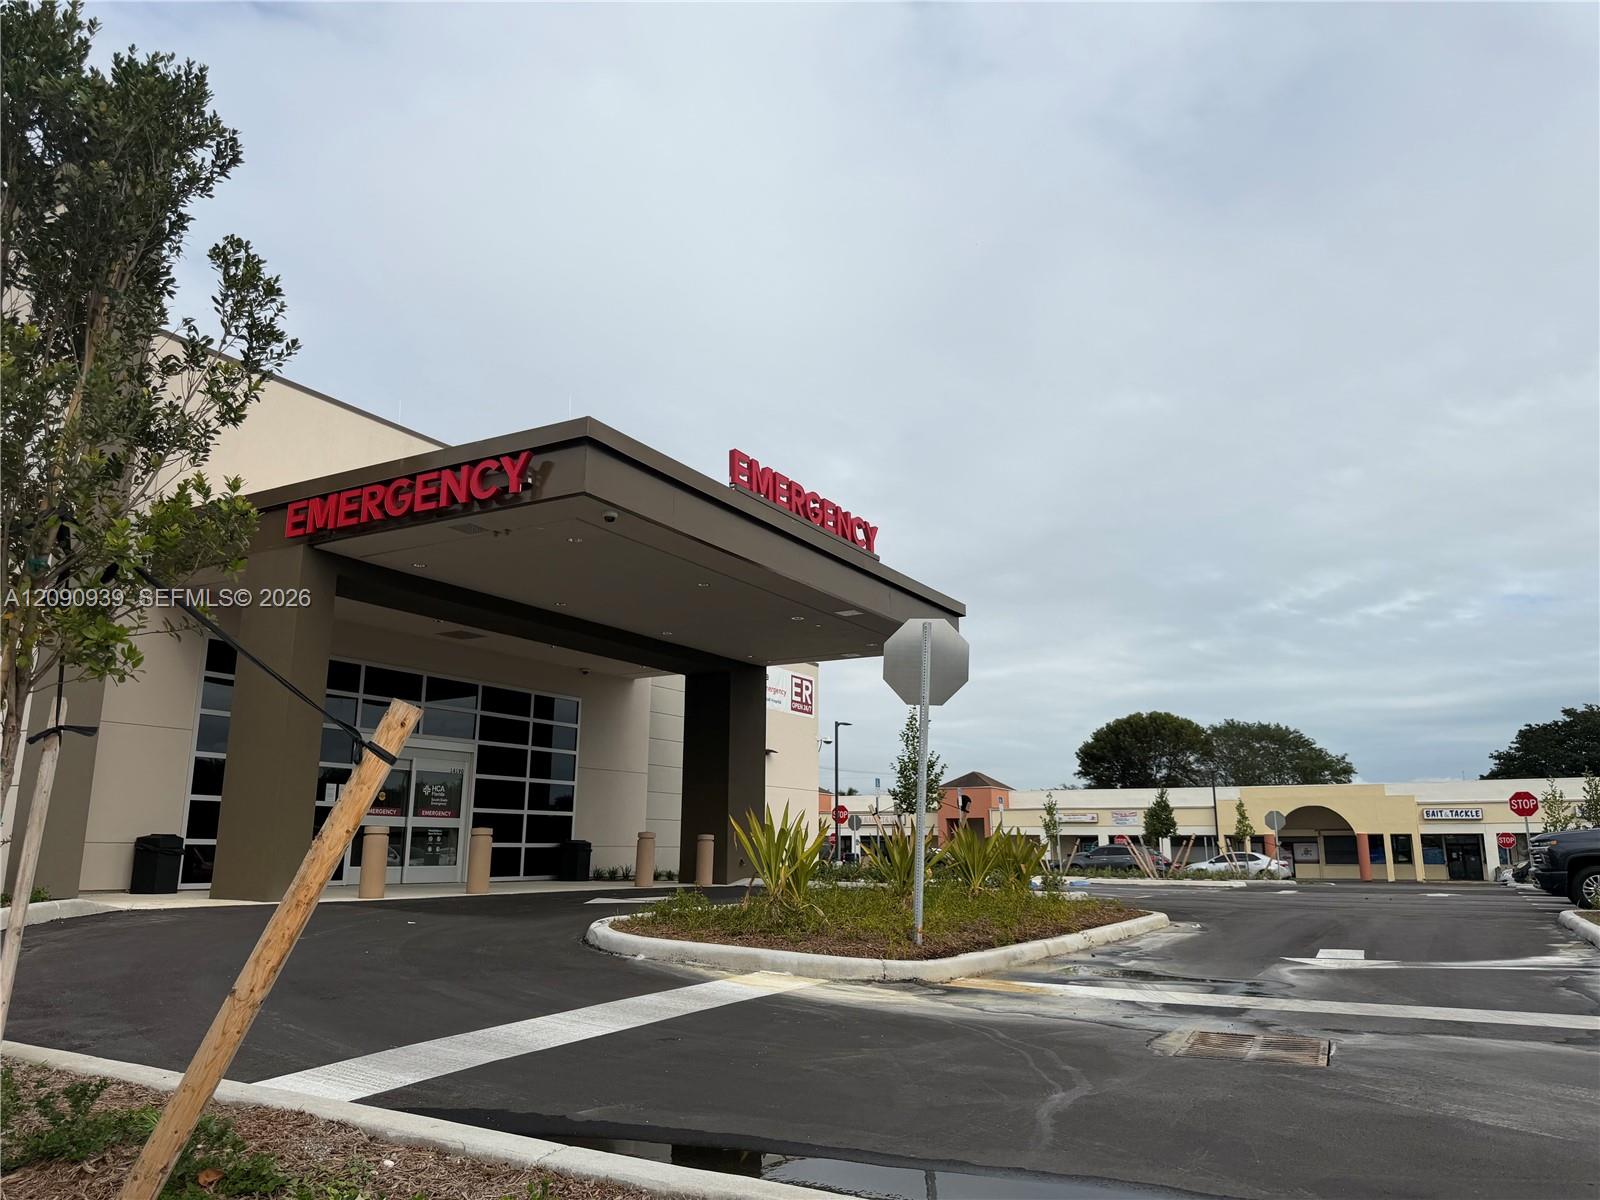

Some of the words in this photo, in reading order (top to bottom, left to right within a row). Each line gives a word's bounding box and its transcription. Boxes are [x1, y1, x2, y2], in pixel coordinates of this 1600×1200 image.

[285, 451, 535, 538] EMERGENCY
[729, 448, 879, 554] EMERGENCY
[767, 686, 787, 697] ergency
[792, 678, 812, 704] ER
[792, 702, 803, 710] OPEN
[1511, 799, 1537, 810] STOP
[832, 810, 848, 819] SOP
[1425, 810, 1443, 818] BAIT
[1449, 810, 1480, 818] TACKLE
[1498, 836, 1515, 845] STOP
